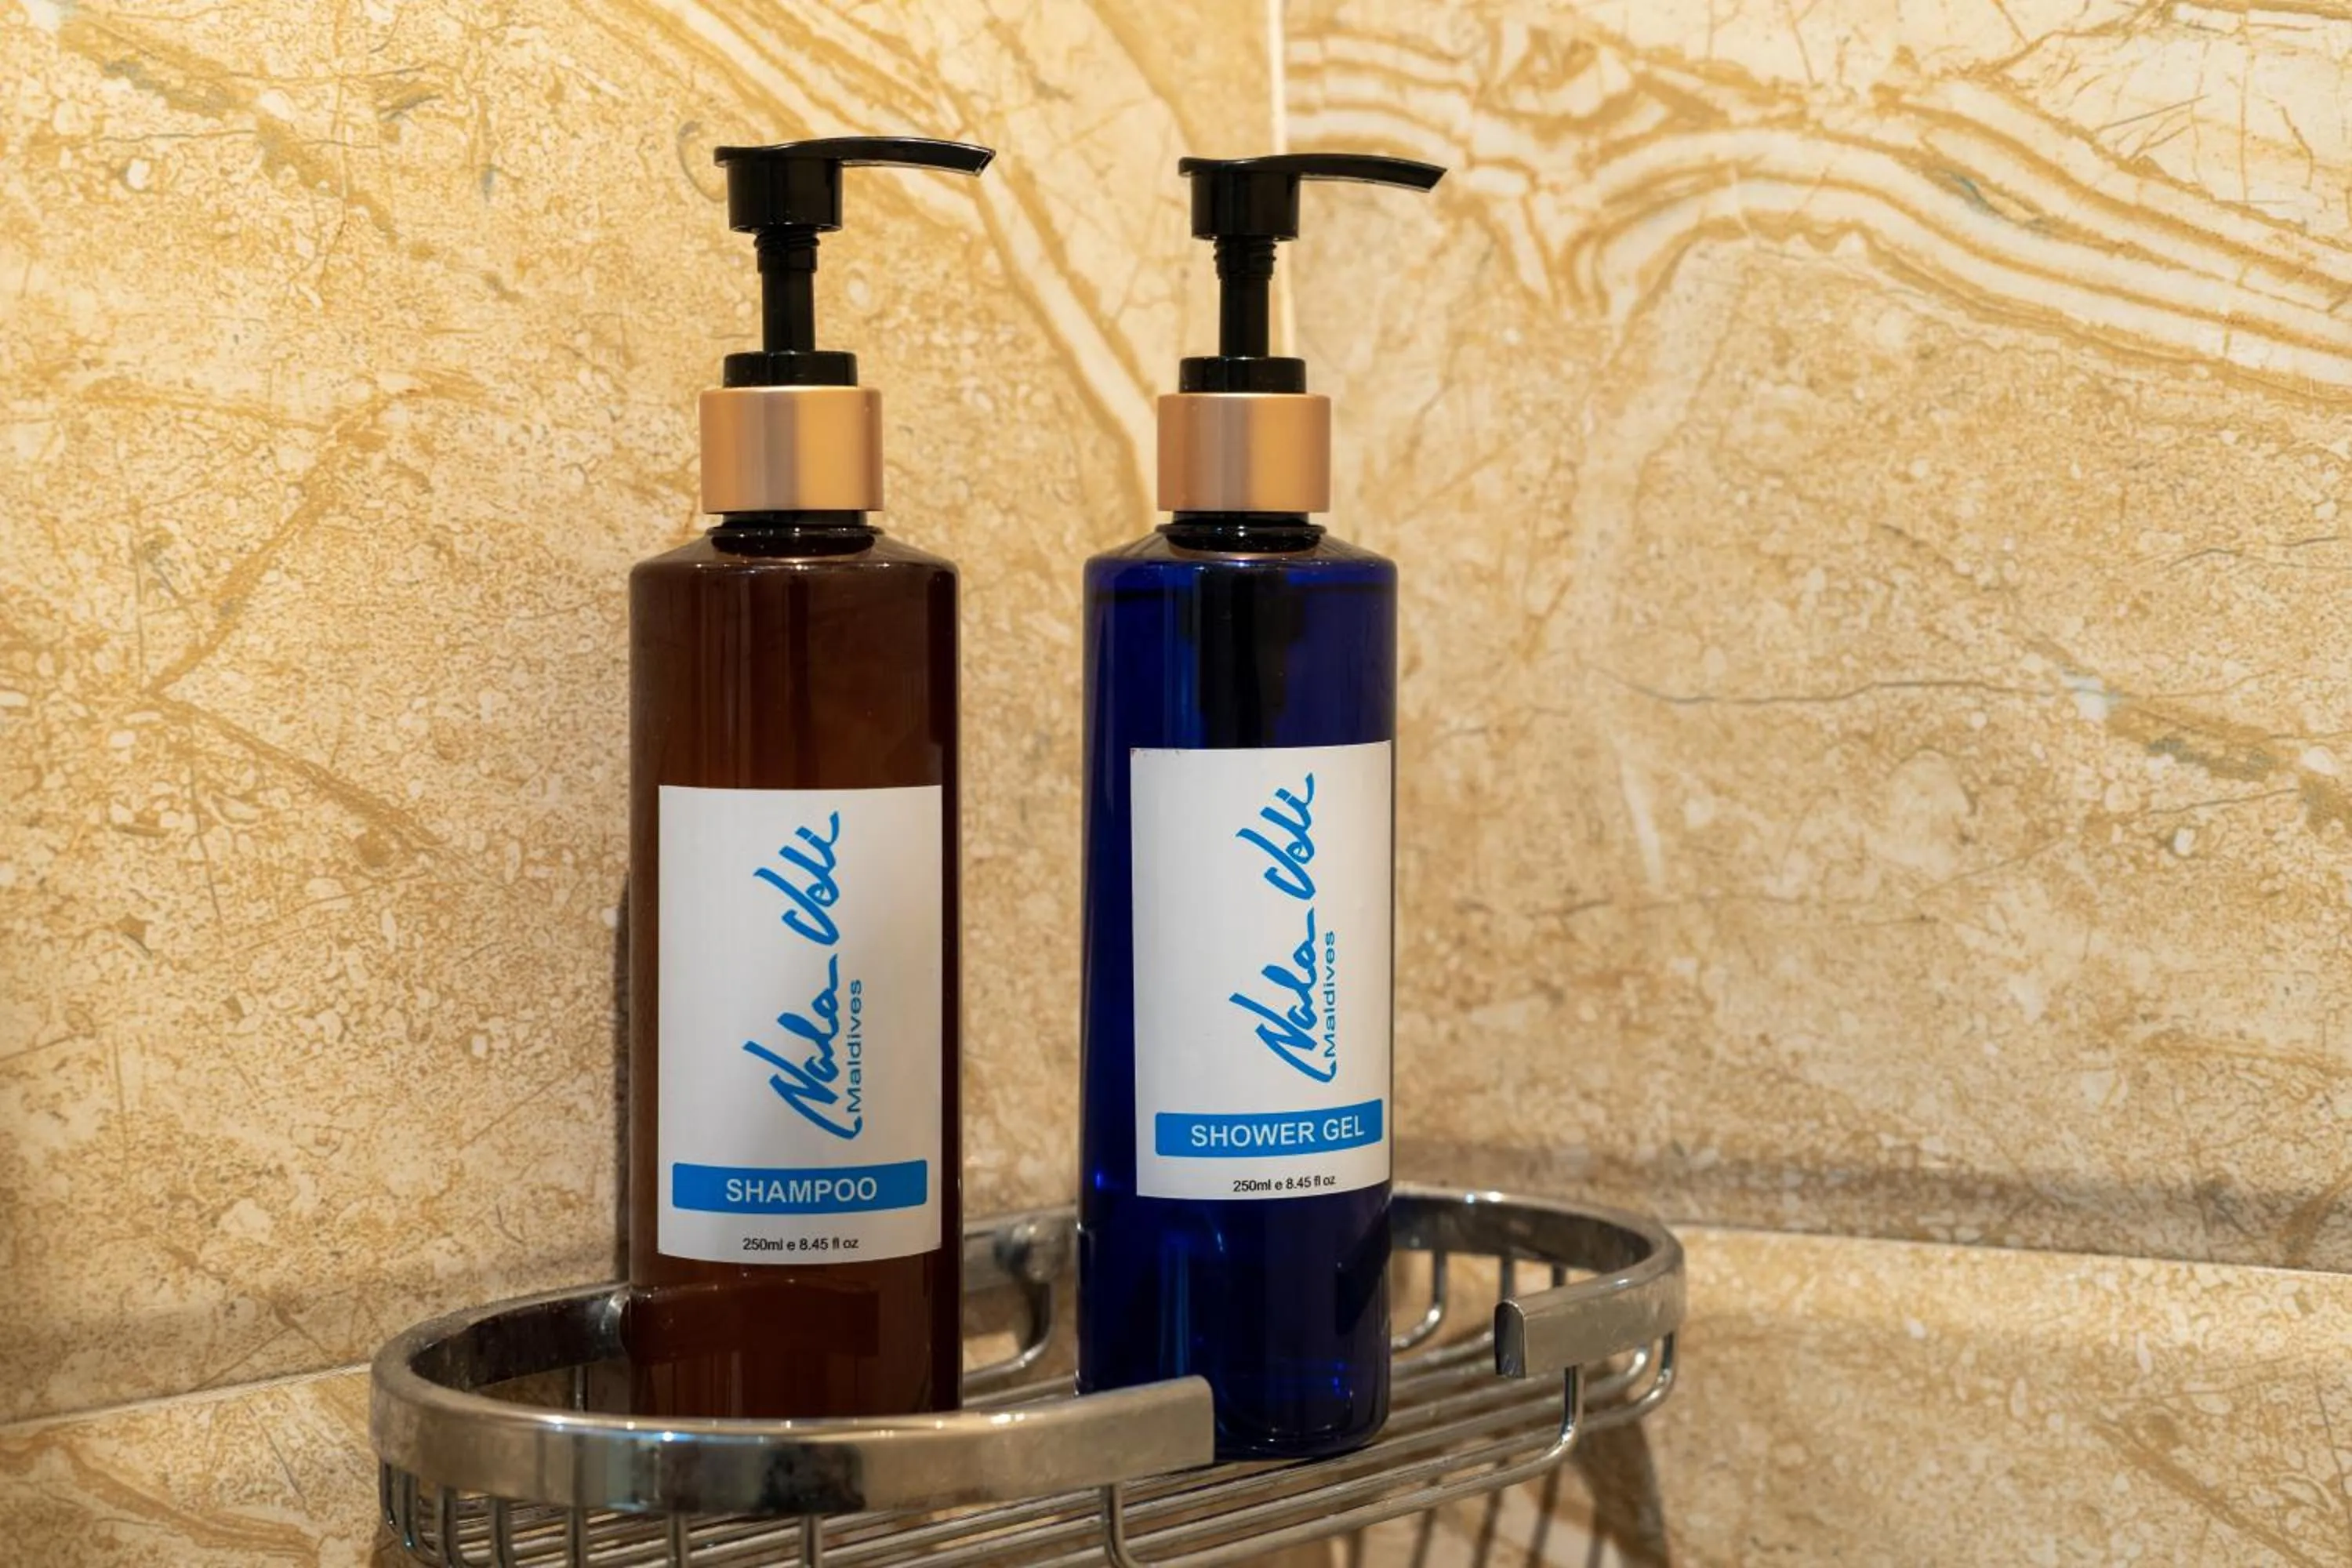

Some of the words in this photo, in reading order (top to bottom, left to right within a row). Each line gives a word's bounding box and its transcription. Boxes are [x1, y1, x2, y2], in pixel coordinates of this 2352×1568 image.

[1229, 906, 1337, 1083] Nala
[1323, 930, 1336, 1058] Maldives
[742, 953, 862, 1141] Nala
[847, 978, 862, 1113] Maldives
[1190, 1121, 1316, 1148] SHOWER
[1322, 1115, 1365, 1142] GEL
[725, 1177, 878, 1203] SHAMPOO
[1232, 1177, 1272, 1192] 250ml
[1285, 1175, 1312, 1189] 8.45
[1314, 1174, 1321, 1187] fl
[1323, 1175, 1337, 1186] oz
[742, 1237, 784, 1251] 250ml
[798, 1237, 829, 1251] 8.45
[832, 1237, 840, 1250] fl
[842, 1238, 859, 1250] oz
